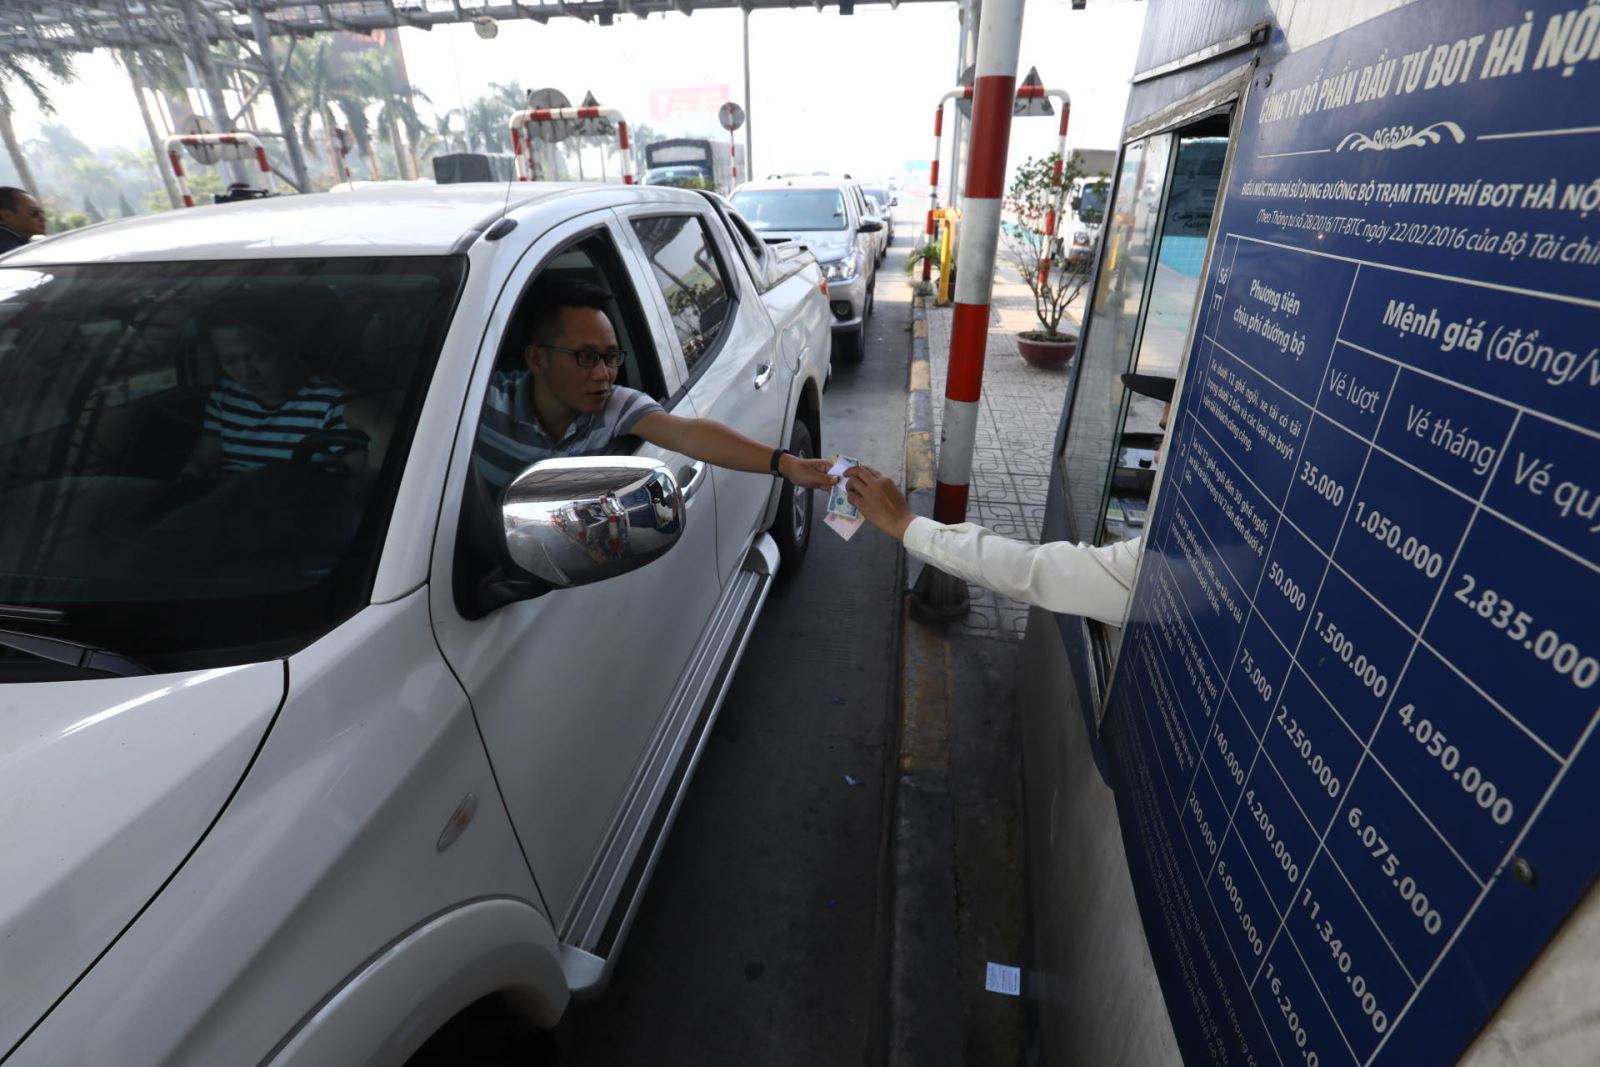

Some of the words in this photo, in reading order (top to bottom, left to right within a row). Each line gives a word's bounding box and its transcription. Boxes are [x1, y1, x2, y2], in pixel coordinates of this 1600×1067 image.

[1285, 88, 1302, 119] TY
[1395, 44, 1433, 95] TƯ
[1424, 34, 1486, 90] BOT
[1265, 182, 1279, 198] THU
[1299, 183, 1323, 202] DỤNG
[1322, 179, 1358, 201] ĐƯỜNG
[1357, 179, 1376, 206] BỘ
[1376, 183, 1412, 208] TRẠM
[1414, 183, 1445, 204] THU
[1445, 178, 1483, 206] PHÍ
[1477, 183, 1524, 207] BOT
[1520, 178, 1557, 210] HÀ
[1363, 220, 1391, 244] ngày
[1389, 222, 1469, 249] 22/02/2016
[1466, 228, 1500, 253] của
[1499, 231, 1528, 261] Bộ
[1529, 233, 1565, 260] Tài
[1249, 279, 1281, 312] Phương
[1280, 291, 1300, 318] tiện
[1382, 299, 1441, 338] Mệnh
[1440, 317, 1487, 352] giá
[1233, 305, 1249, 328] chịu
[1247, 312, 1264, 333] phí
[1261, 317, 1291, 353] đường
[1289, 330, 1306, 361] bộ
[1228, 371, 1235, 385] 12
[1259, 399, 1268, 412] xe
[1268, 404, 1279, 420] tải
[1278, 414, 1288, 427] có
[1289, 419, 1302, 437] tải
[1329, 368, 1348, 397] Vé
[1346, 377, 1380, 414] lượt
[1227, 394, 1233, 406] 2
[1246, 412, 1256, 428] các
[1255, 417, 1269, 439] loại
[1266, 431, 1276, 445] xe
[1275, 435, 1293, 460] buýt
[1406, 404, 1432, 438] Vé
[1430, 419, 1496, 476] tháng
[1300, 461, 1345, 507] 35.000
[1514, 452, 1554, 495] Vé
[1554, 481, 1600, 532] qu
[1233, 514, 1244, 534] đến
[1243, 528, 1258, 551] dưới
[1257, 545, 1263, 557] 4
[1239, 497, 1254, 518] ghế
[1251, 512, 1268, 538] ngồi,
[1354, 501, 1443, 578] 1.050.000
[1268, 561, 1306, 611] 50.000
[1314, 611, 1388, 698] 1.500.000
[1454, 574, 1600, 689] 2.835.000
[1239, 648, 1272, 702] 75.000
[1212, 723, 1244, 786] 140.000
[1276, 705, 1340, 798] 2.250.000
[1398, 703, 1514, 825] 4.050.000
[1189, 792, 1217, 855] 200.000
[1246, 790, 1299, 883] 4.200.000
[1348, 807, 1442, 935] 6.075.000
[1217, 860, 1263, 956] 6.000.000
[1302, 887, 1387, 1033] 11.340.000
